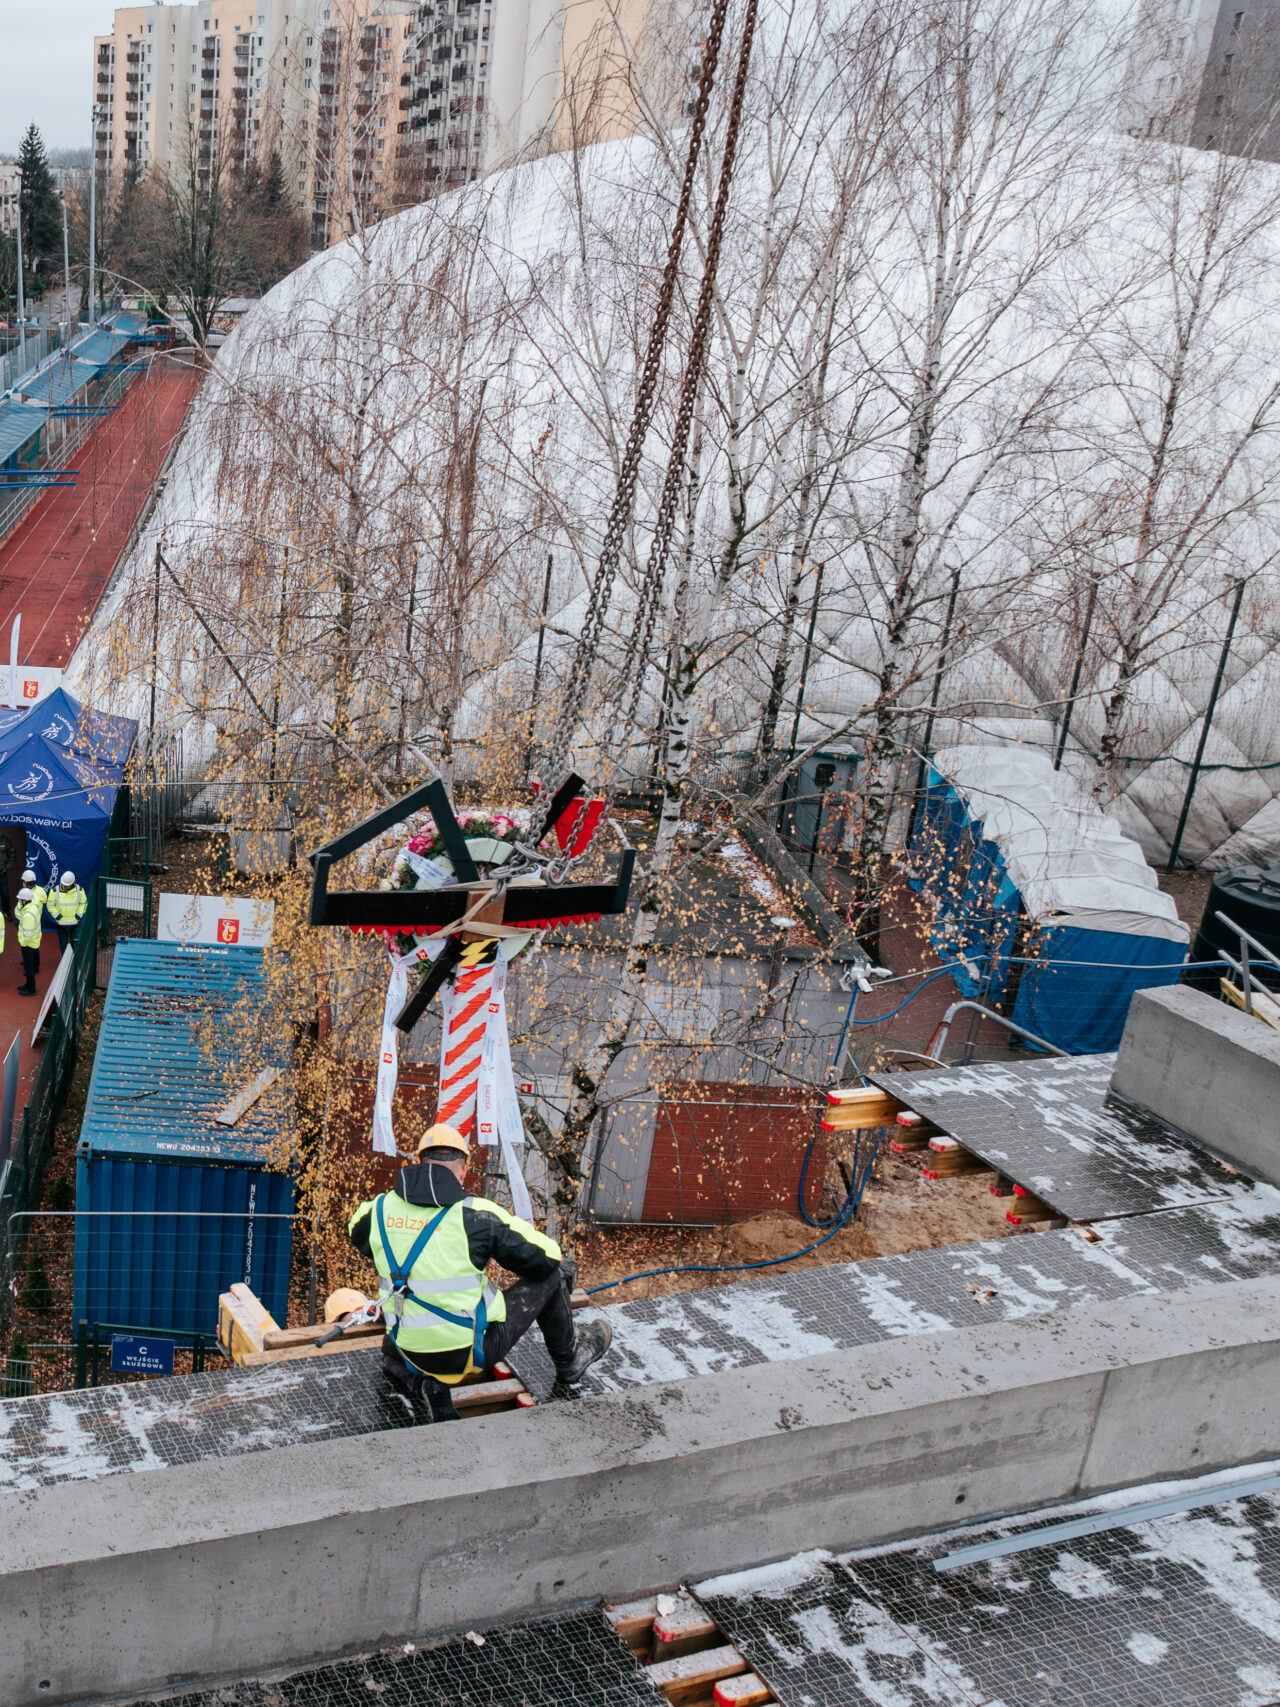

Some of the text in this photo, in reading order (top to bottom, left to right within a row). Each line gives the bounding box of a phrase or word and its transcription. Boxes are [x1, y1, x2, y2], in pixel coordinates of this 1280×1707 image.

[138, 1346, 148, 1355] C
[126, 1355, 160, 1364] WEJŚCIE
[121, 1360, 164, 1370] SŁUŻBOWE
